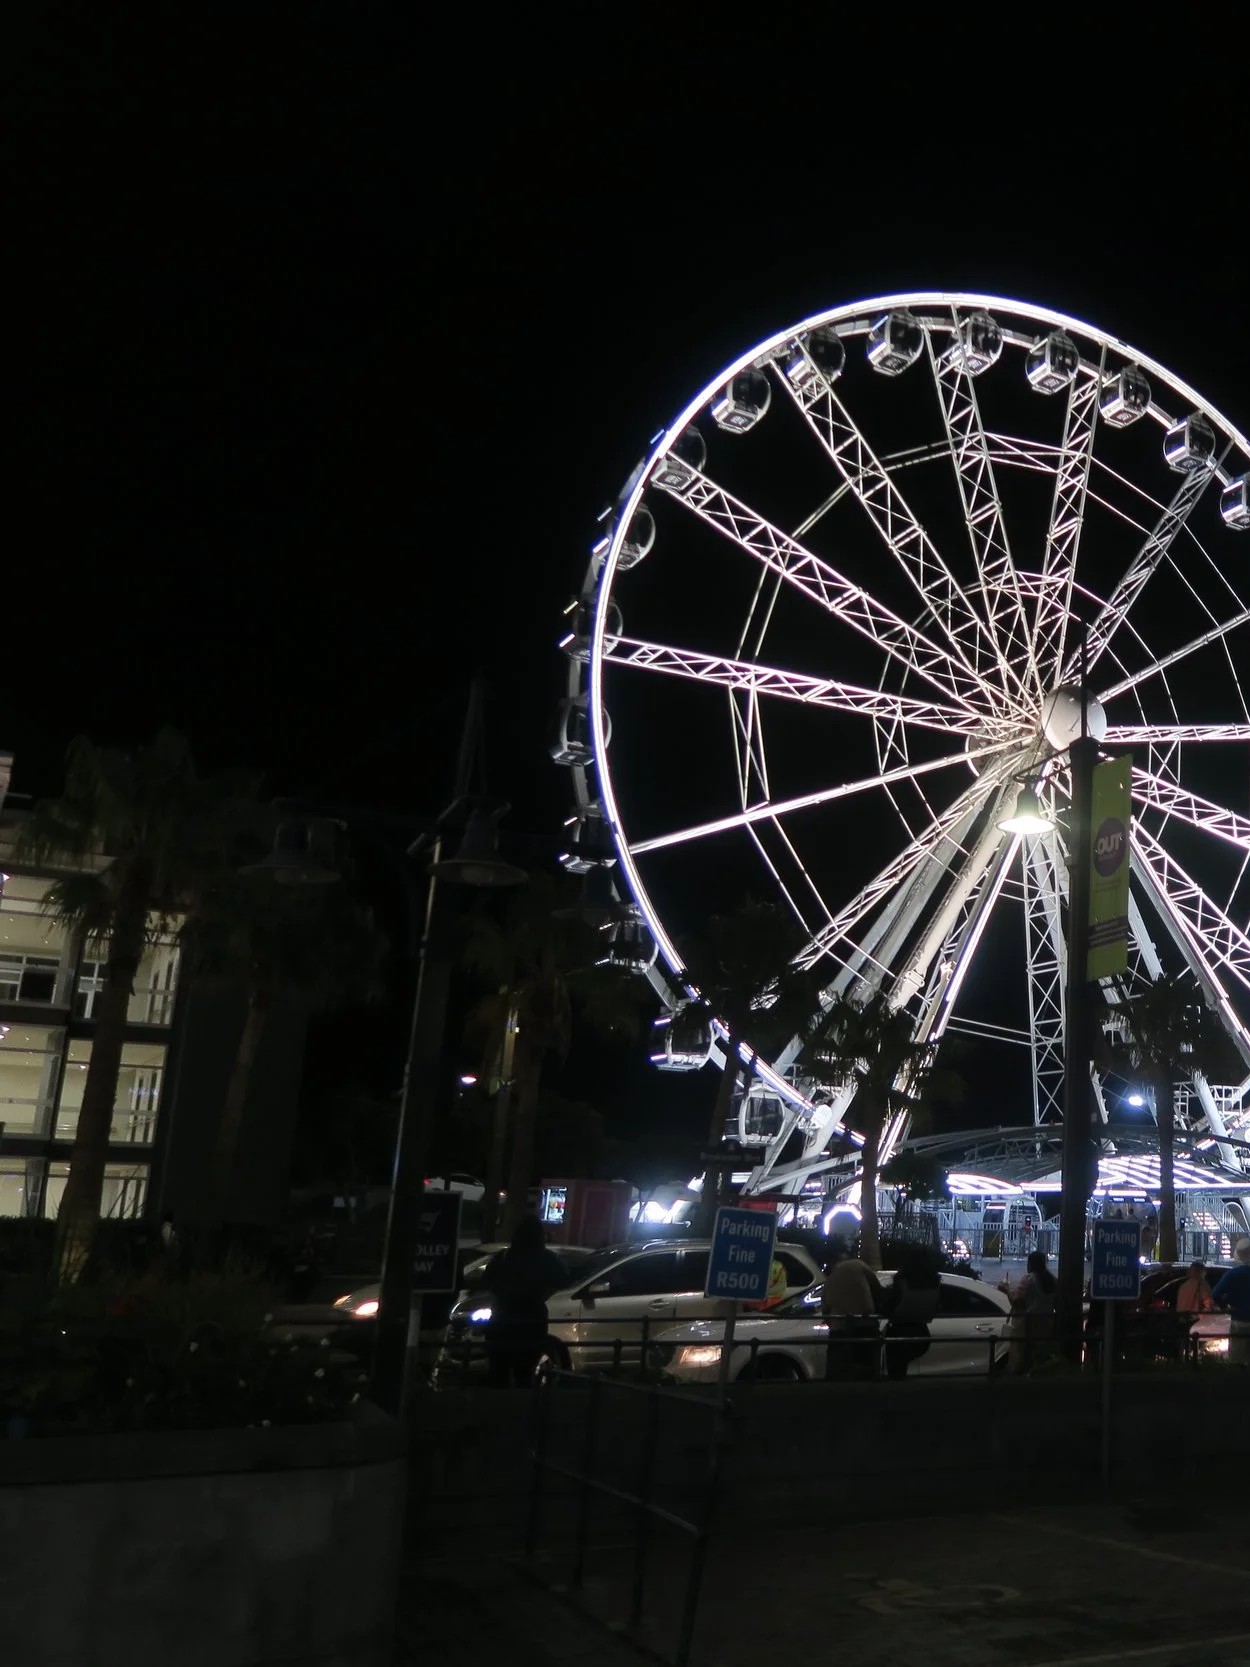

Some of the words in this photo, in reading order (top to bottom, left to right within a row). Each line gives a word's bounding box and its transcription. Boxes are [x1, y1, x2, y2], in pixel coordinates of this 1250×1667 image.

[720, 1217, 770, 1243] Parking
[1097, 1228, 1137, 1248] Parking
[728, 1244, 756, 1263] Fine
[1106, 1251, 1128, 1268] Fine
[716, 1271, 760, 1290] R500
[1100, 1273, 1133, 1289] R500
